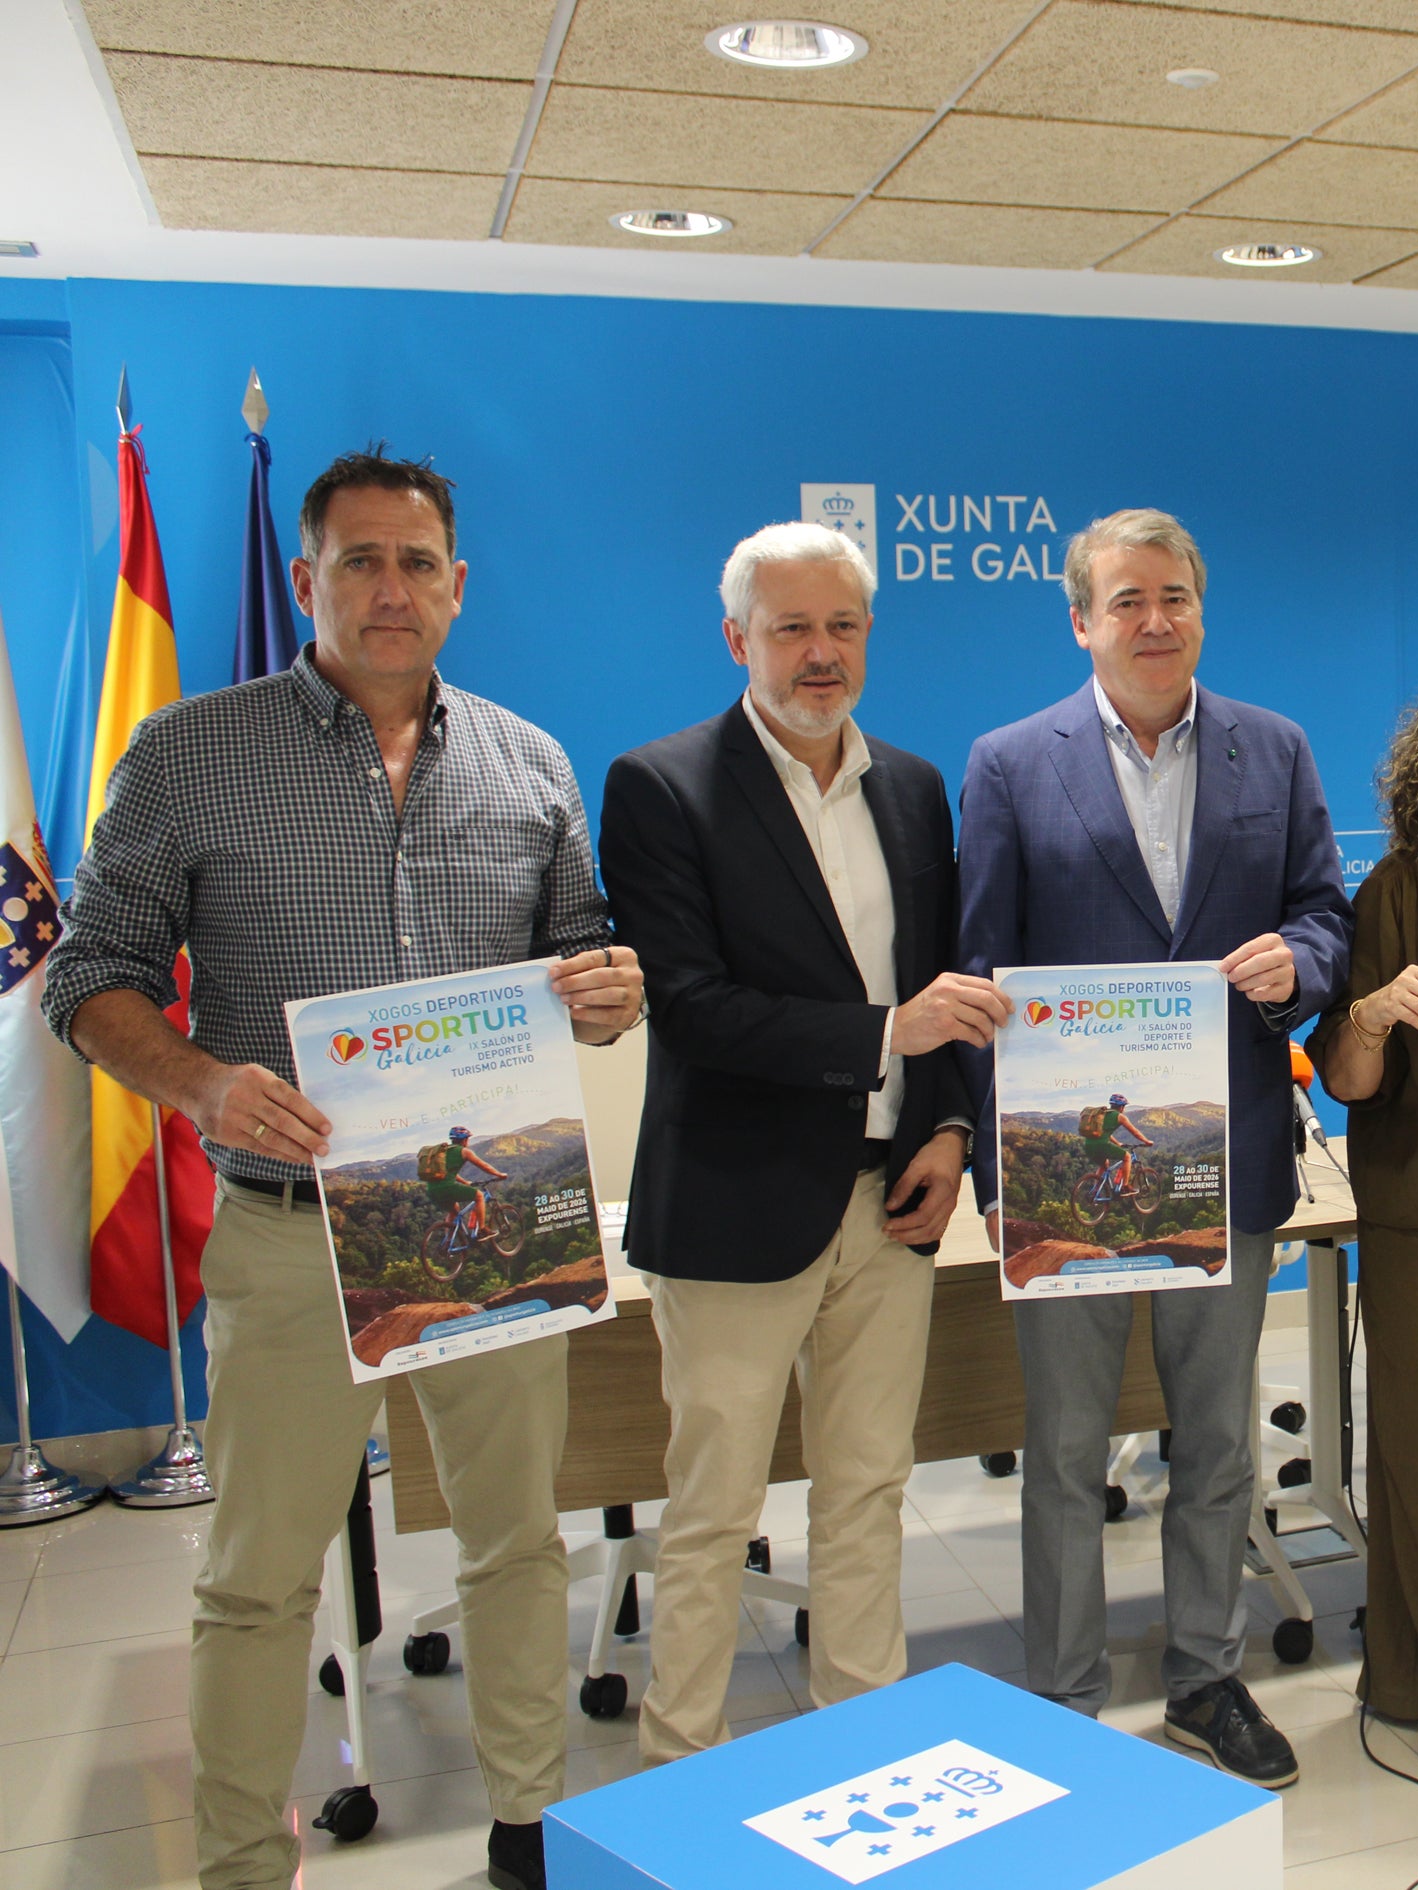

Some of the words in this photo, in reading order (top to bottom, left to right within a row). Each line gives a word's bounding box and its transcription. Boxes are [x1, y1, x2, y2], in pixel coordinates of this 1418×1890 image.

[895, 494, 1057, 533] XUNTA
[895, 543, 954, 581] DE
[971, 543, 1065, 582] GAL
[1060, 983, 1104, 995] XOGOS
[1108, 981, 1191, 994] DEPORTIVOS
[368, 1002, 422, 1023] XOGOS
[426, 985, 524, 1014] DEPORTIVOS
[1059, 997, 1192, 1020] SPORTUR
[371, 1004, 528, 1051] SPORTUR
[1060, 1017, 1126, 1037] Galicia
[1148, 1021, 1178, 1031] SALÓN
[1180, 1022, 1192, 1030] DO
[469, 1041, 479, 1051] IX
[480, 1034, 515, 1050] SALÓN
[517, 1032, 531, 1042] DO
[1144, 1033, 1184, 1041] DEPORTE
[1186, 1032, 1192, 1040] E
[478, 1045, 524, 1061] DEPORTE
[526, 1043, 533, 1052] E
[1120, 1043, 1159, 1052] TURISMO
[1161, 1042, 1192, 1051] ACTIVO
[376, 1043, 455, 1071] Galicia
[451, 1062, 497, 1078] TURISMO
[499, 1054, 535, 1069] ACTIVO
[1173, 1165, 1185, 1175] 28
[1196, 1164, 1209, 1173] 30
[1209, 1165, 1220, 1173] DE
[1174, 1175, 1192, 1183] MAIO
[1192, 1174, 1203, 1182] DE
[1174, 1181, 1220, 1191] EXPOURENSE
[534, 1195, 548, 1207] 28
[549, 1195, 560, 1204] AO
[560, 1188, 574, 1200] 30
[575, 1188, 586, 1197] DE
[536, 1204, 557, 1215] MAIO
[557, 1201, 568, 1210] DE
[538, 1205, 589, 1224] EXPOURENSE
